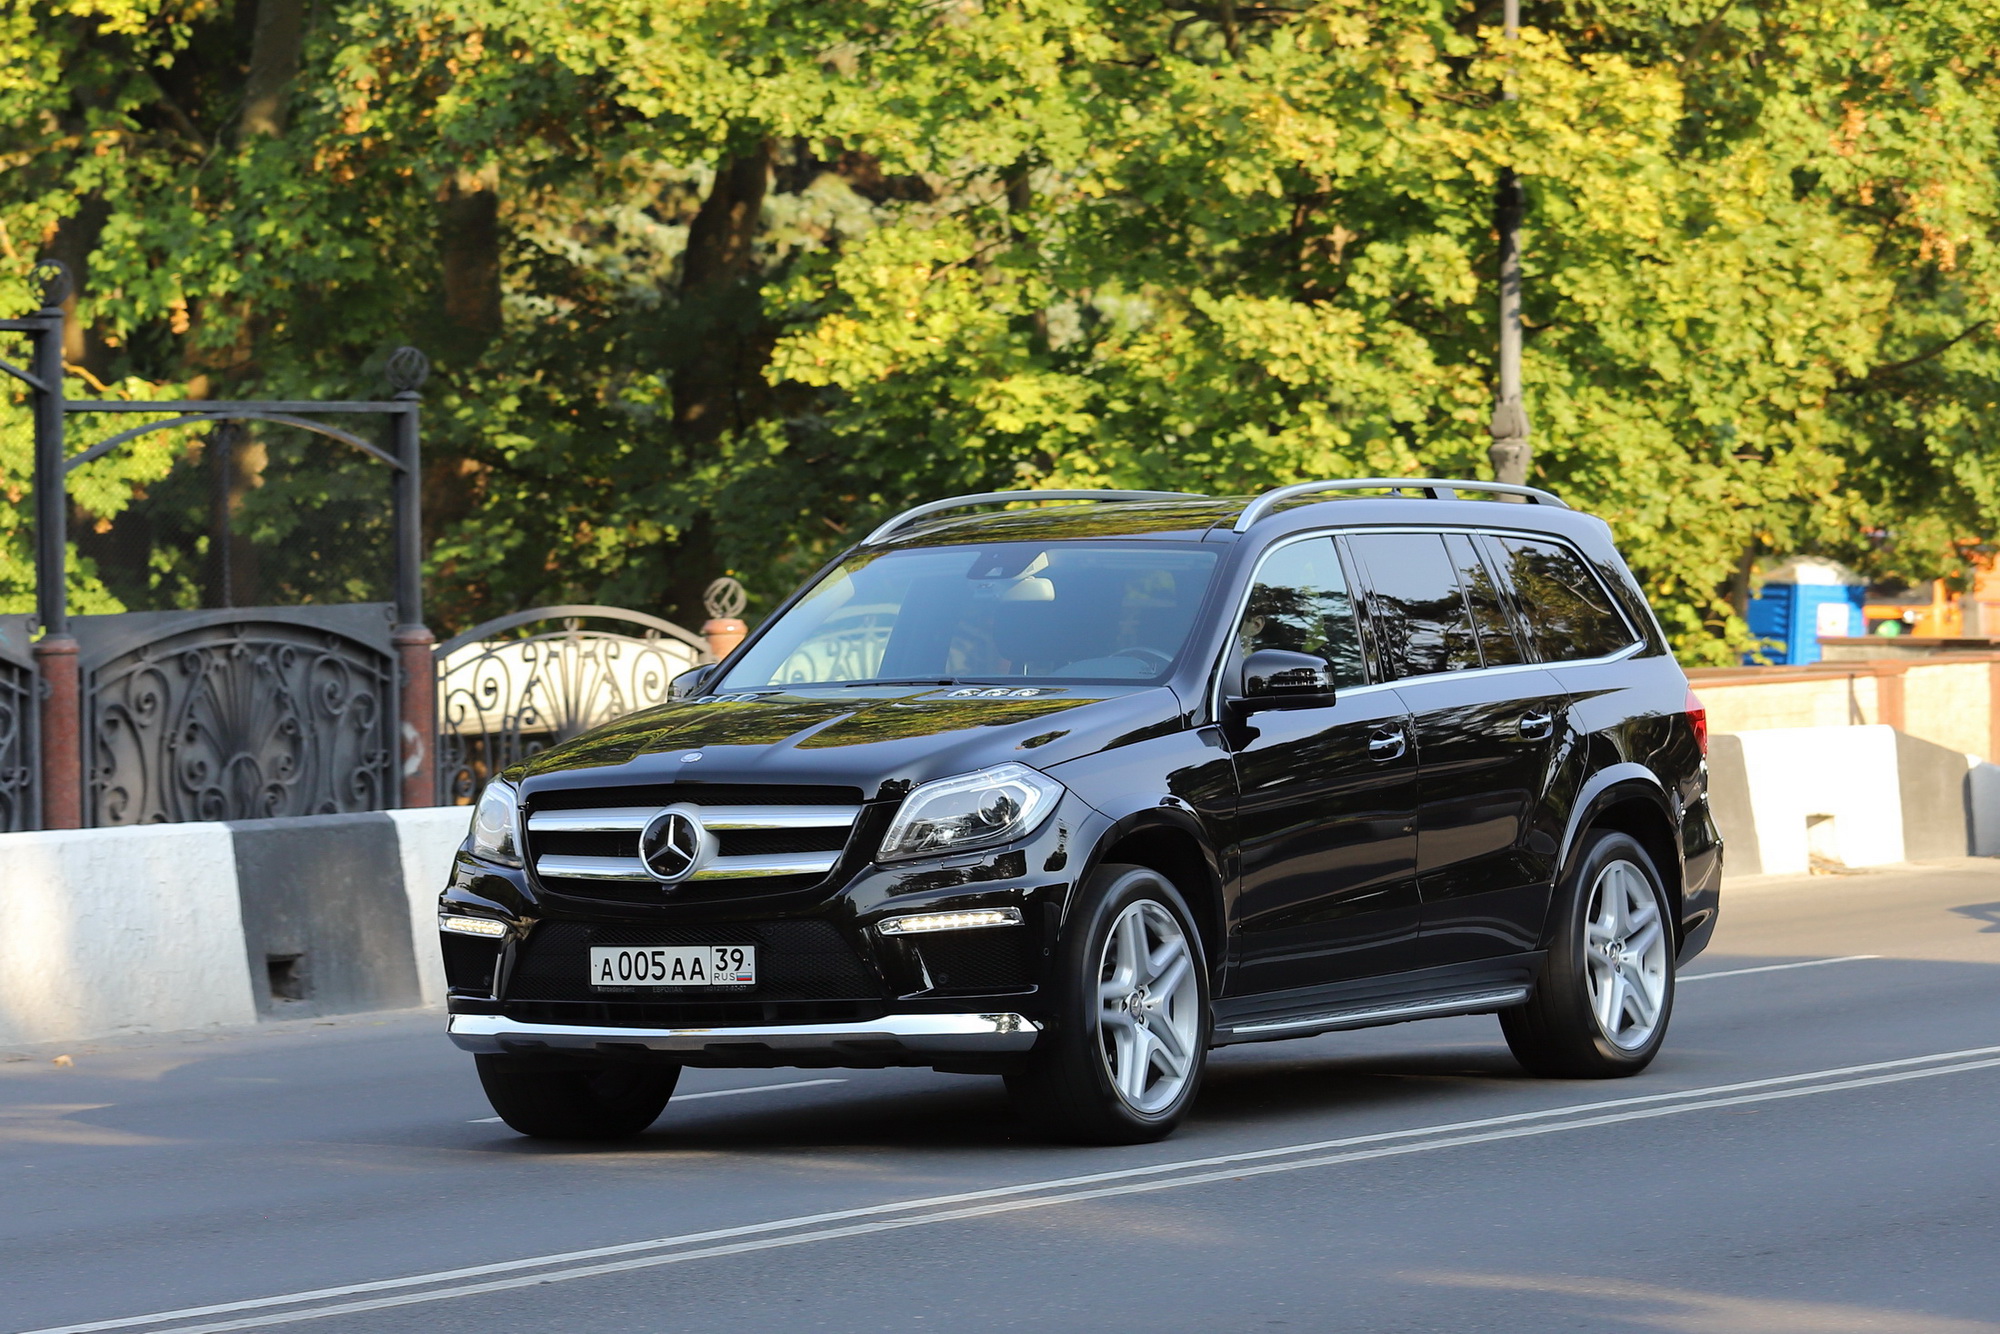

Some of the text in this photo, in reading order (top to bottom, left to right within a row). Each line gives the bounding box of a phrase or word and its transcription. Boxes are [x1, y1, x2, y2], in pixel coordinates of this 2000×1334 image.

[601, 948, 744, 981] A005AA 39
[714, 972, 735, 981] RUS
